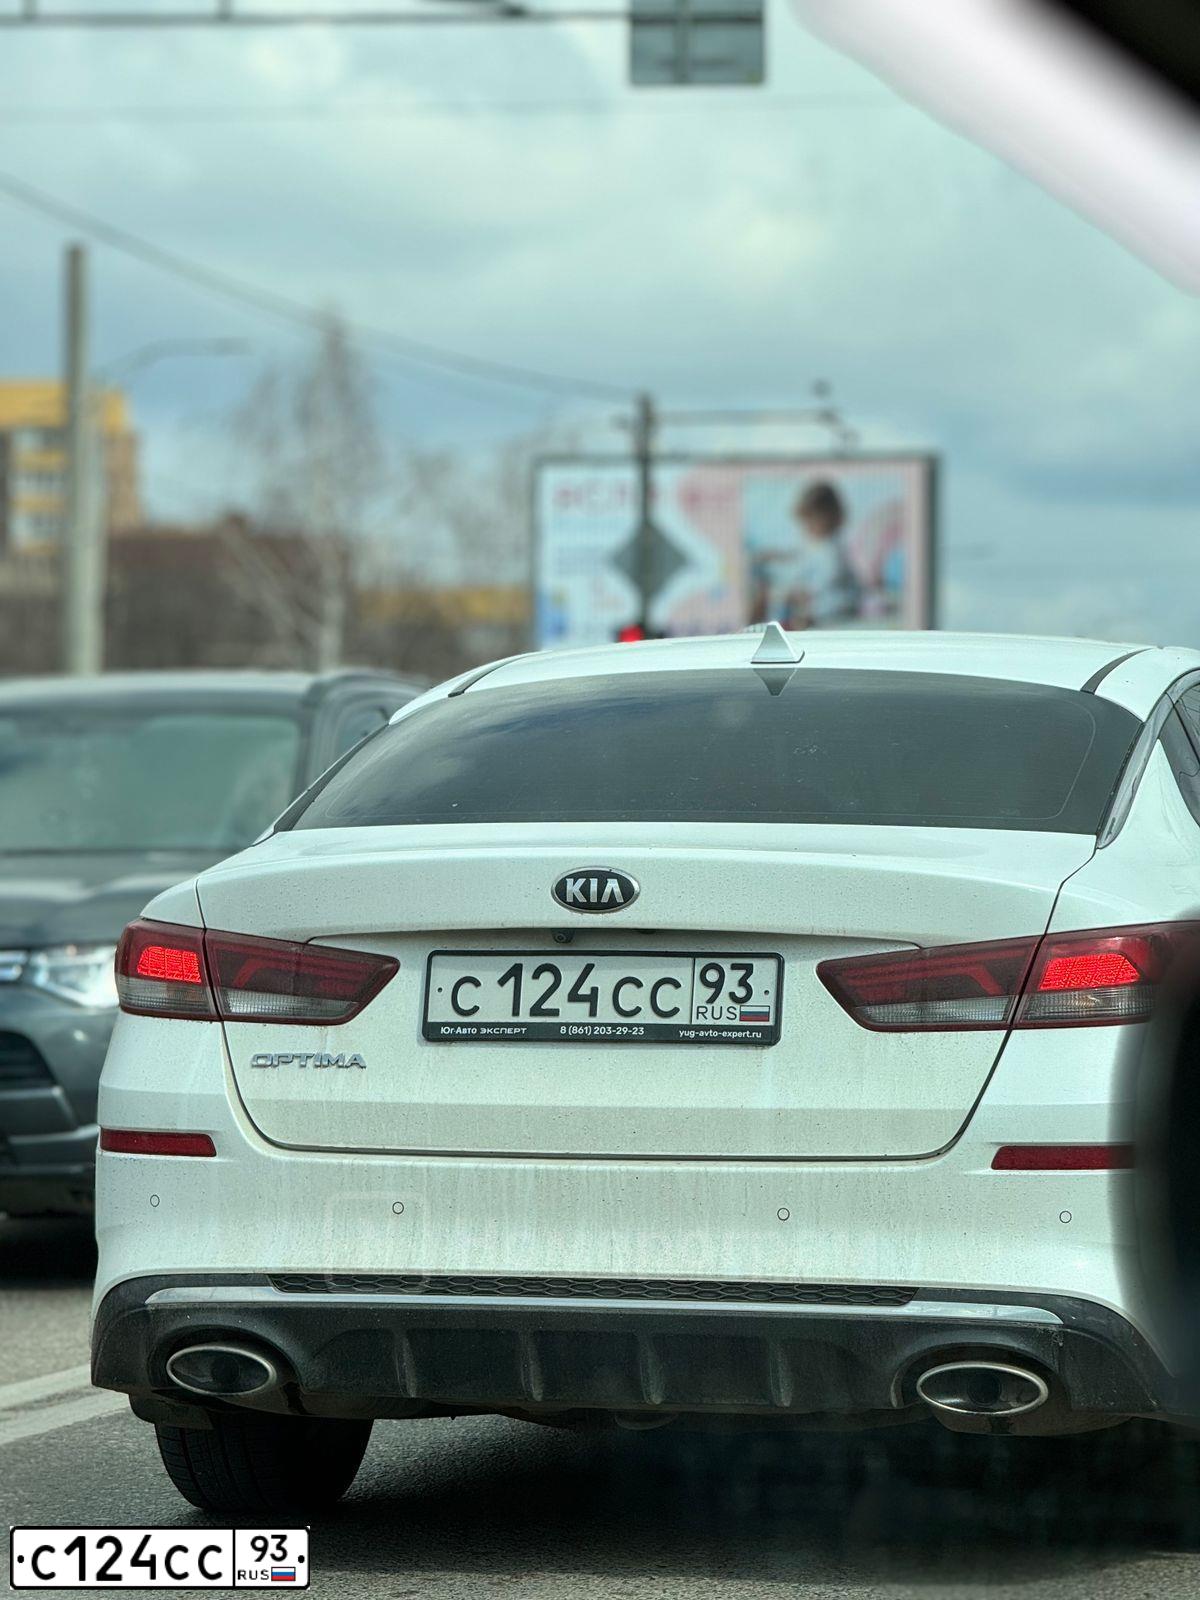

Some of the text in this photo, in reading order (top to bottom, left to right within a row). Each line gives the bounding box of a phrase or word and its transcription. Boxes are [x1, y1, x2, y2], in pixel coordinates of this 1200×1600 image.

[566, 879, 624, 902] KIA
[700, 962, 754, 1004] 93
[696, 1006, 737, 1021] RUS
[480, 1027, 527, 1035] ЭКСПЕРТ
[560, 1025, 645, 1036] 8 (861) 203-29-23
[679, 1029, 762, 1040] yug-avto-expert.ru
[251, 1053, 367, 1069] OPTIMA
